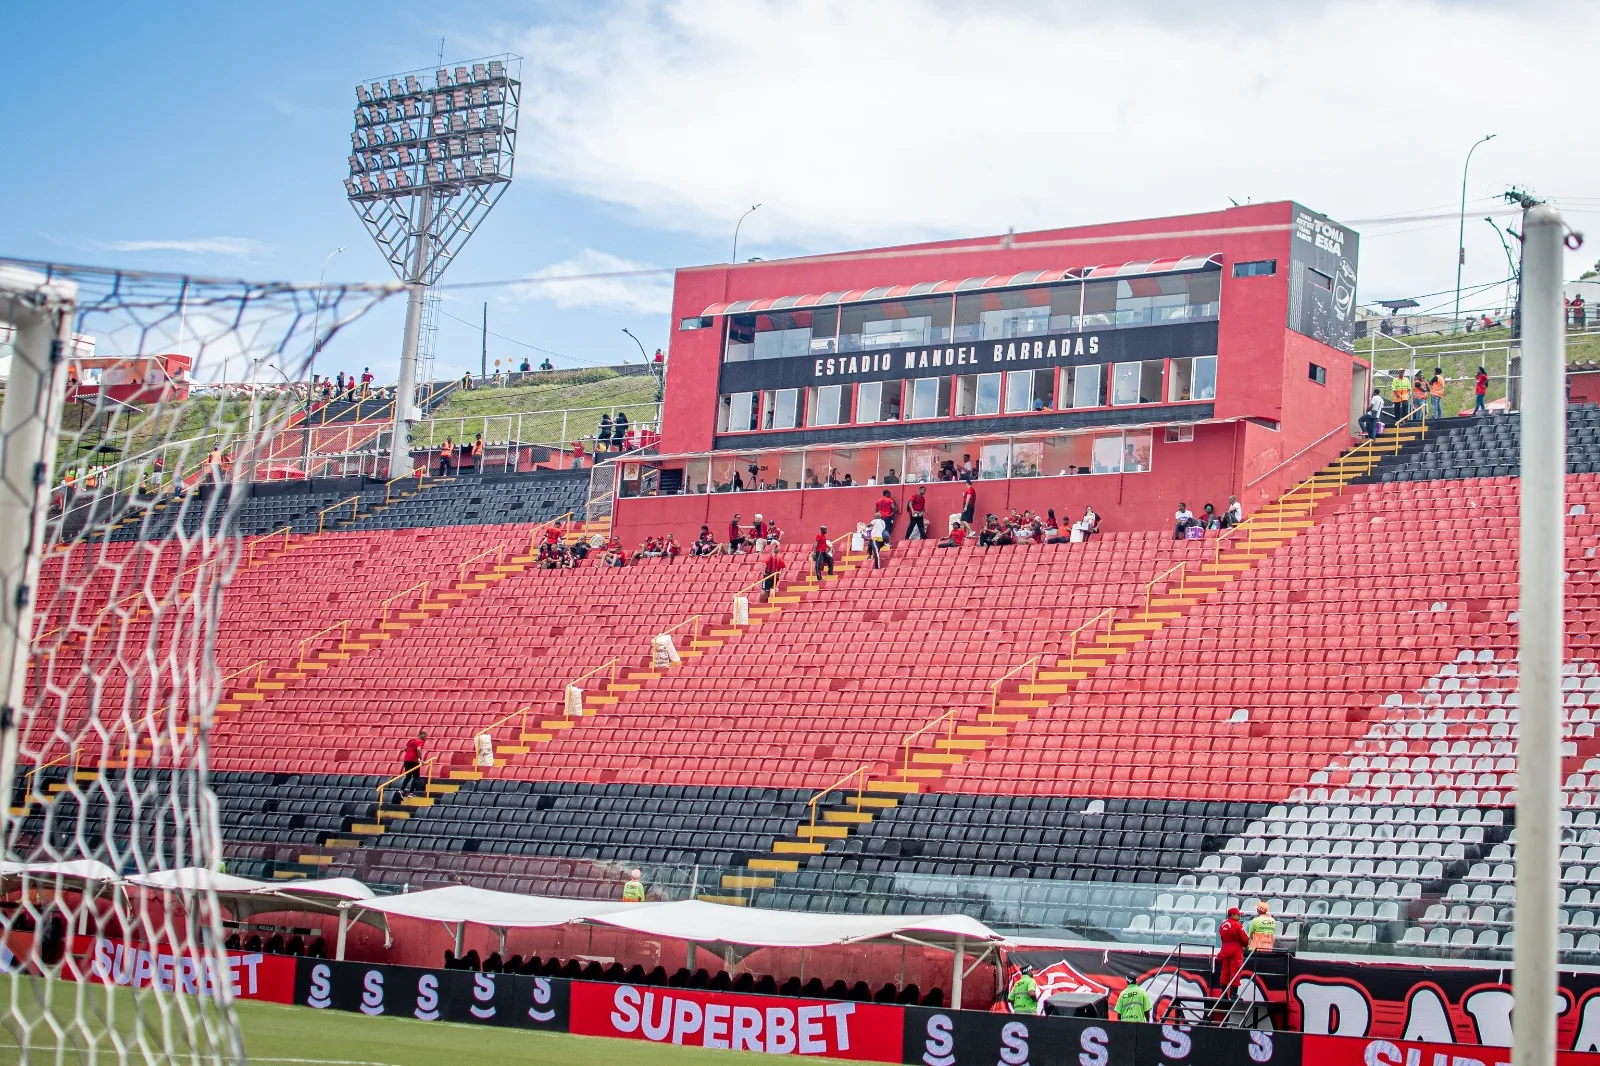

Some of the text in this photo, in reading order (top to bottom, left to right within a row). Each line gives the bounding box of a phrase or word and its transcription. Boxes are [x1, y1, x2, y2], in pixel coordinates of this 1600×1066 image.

[1313, 219, 1344, 244] TOMA
[1315, 233, 1341, 257] ESSA
[814, 336, 1100, 377] ESTADIO MANOEL BARRADAS
[91, 938, 264, 997] SUPERBET
[610, 984, 856, 1055] SUPERBET
